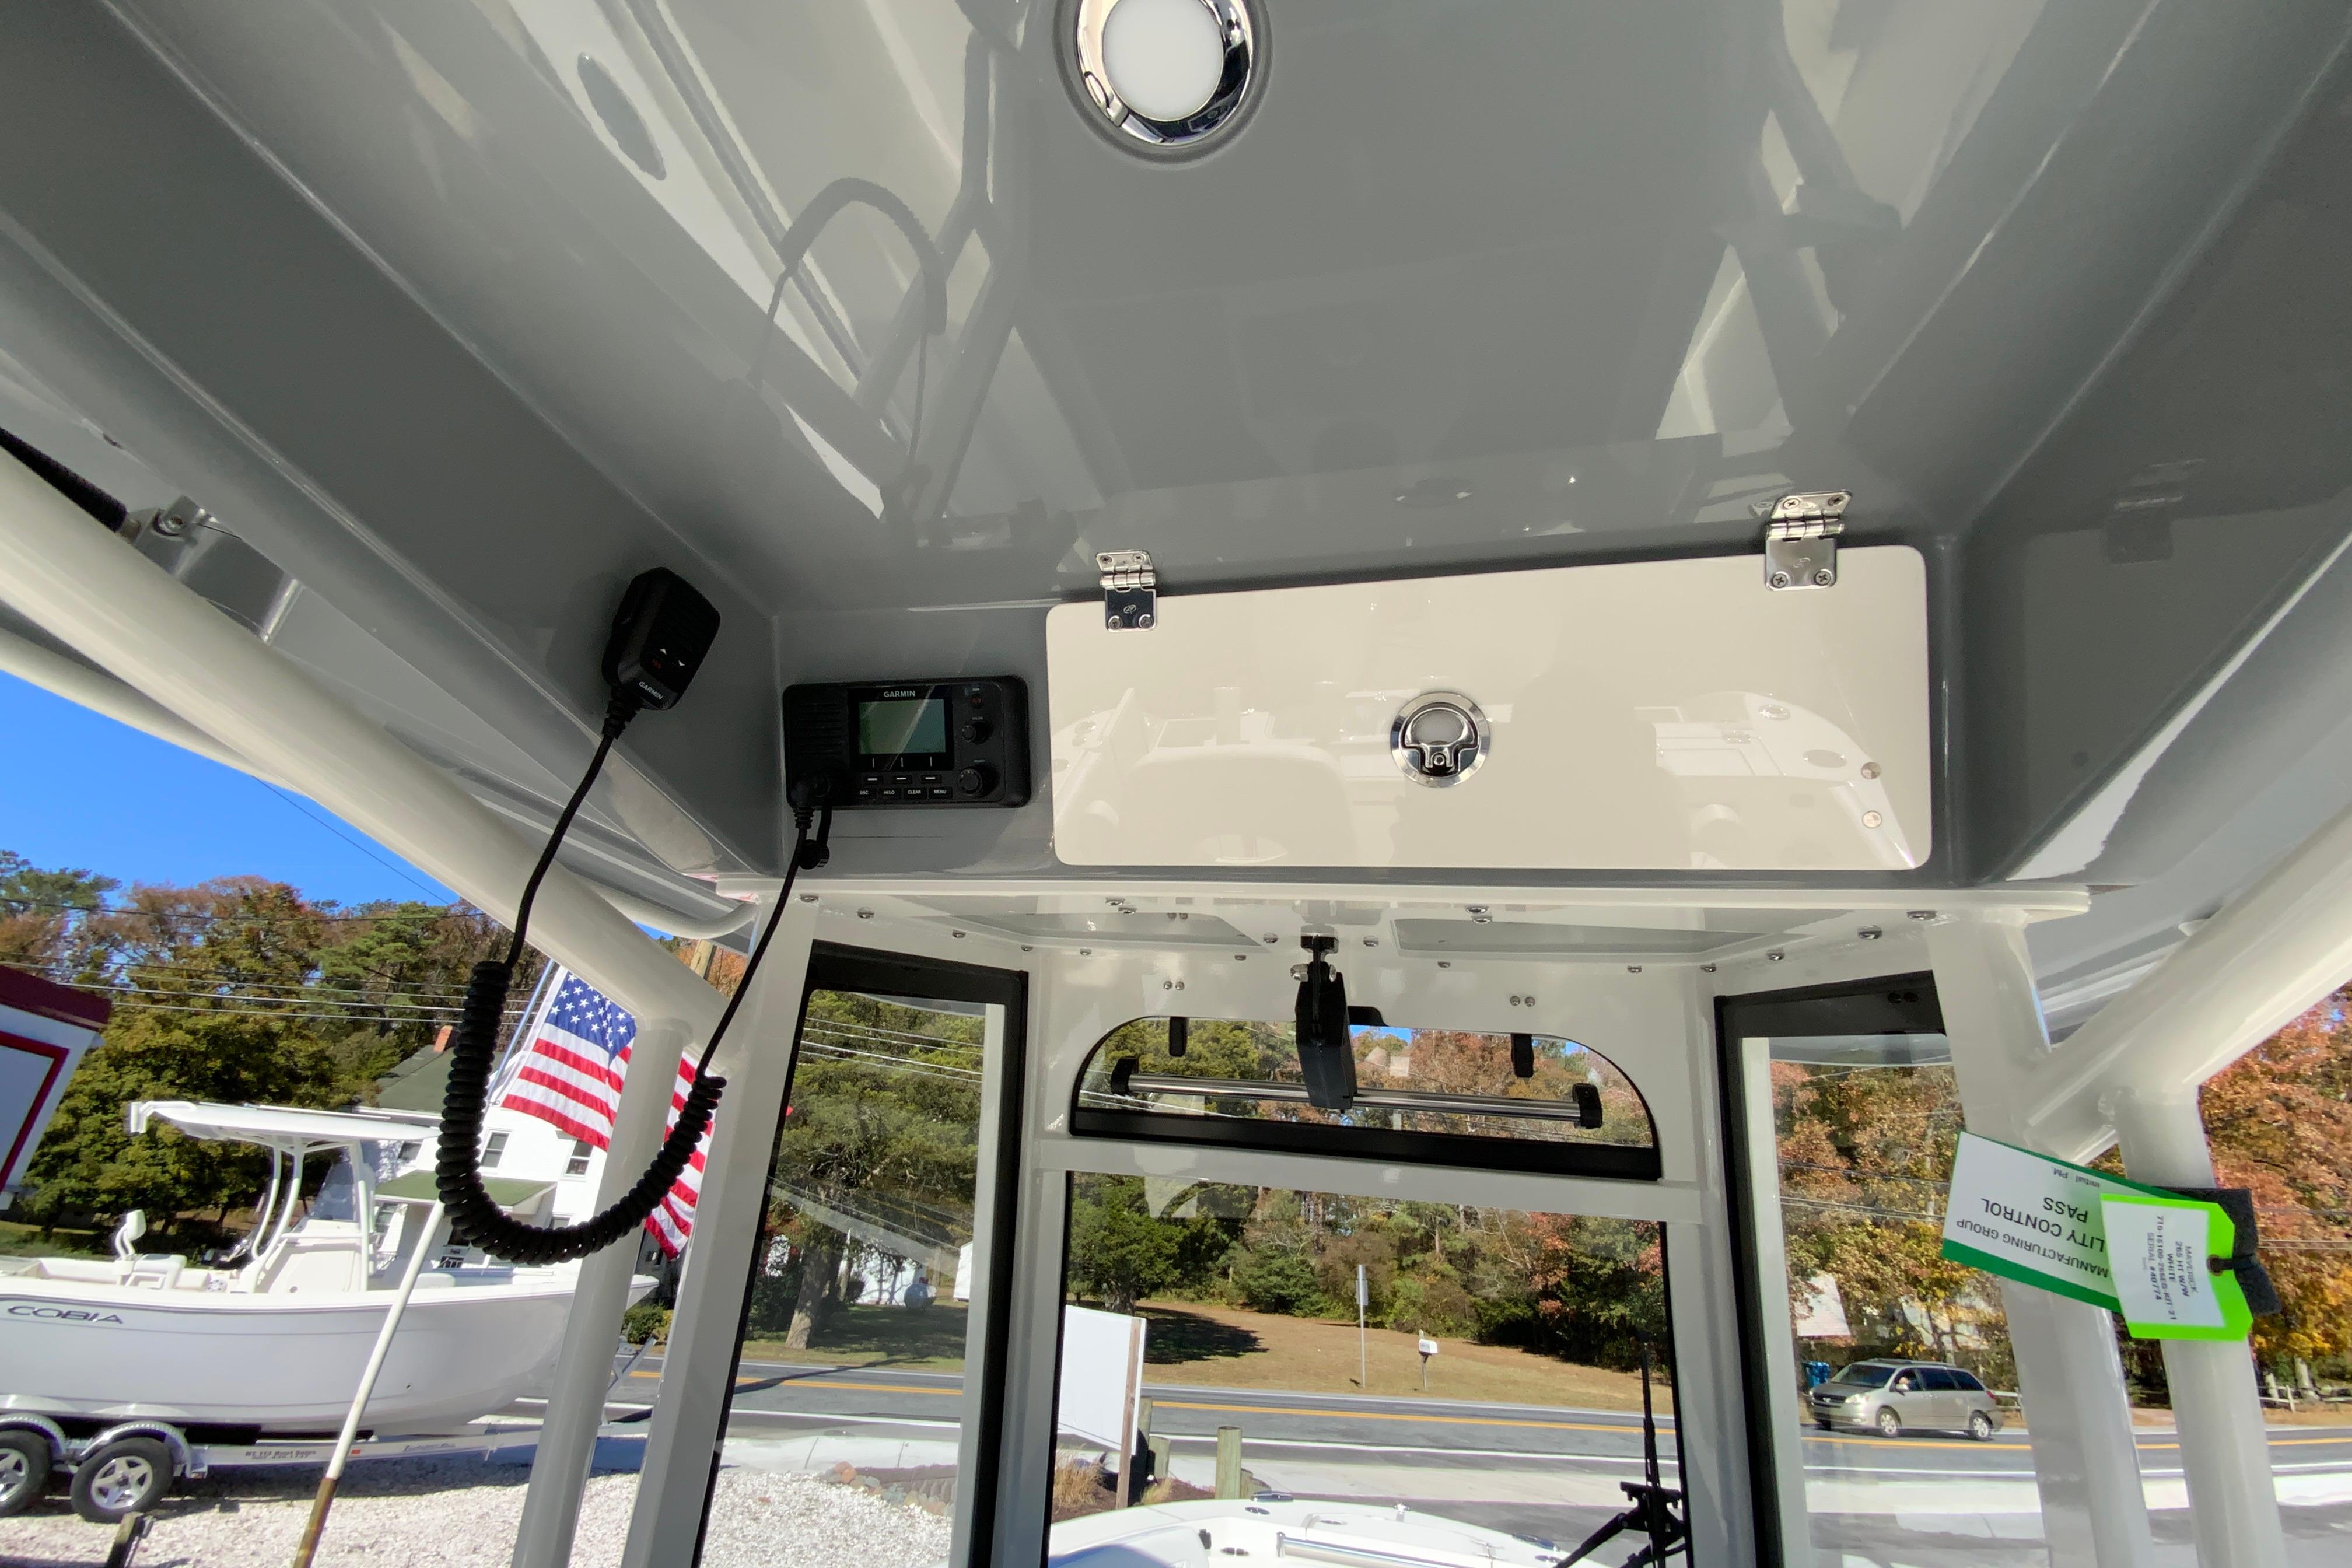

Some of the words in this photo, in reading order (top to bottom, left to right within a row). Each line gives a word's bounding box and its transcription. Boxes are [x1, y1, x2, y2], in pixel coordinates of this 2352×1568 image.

[639, 681, 664, 699] GARMIN
[1981, 1198, 2062, 1237] CONTROL
[2043, 1197, 2088, 1223] PASS
[1957, 1219, 1999, 1240] GROUP
[2003, 1233, 2108, 1278] MANUFACTURING
[2147, 1232, 2155, 1261] SERIAL
[2167, 1253, 2176, 1282] WHITE
[2185, 1245, 2199, 1293] MAVERICK
[8, 1306, 123, 1324] COBIA
